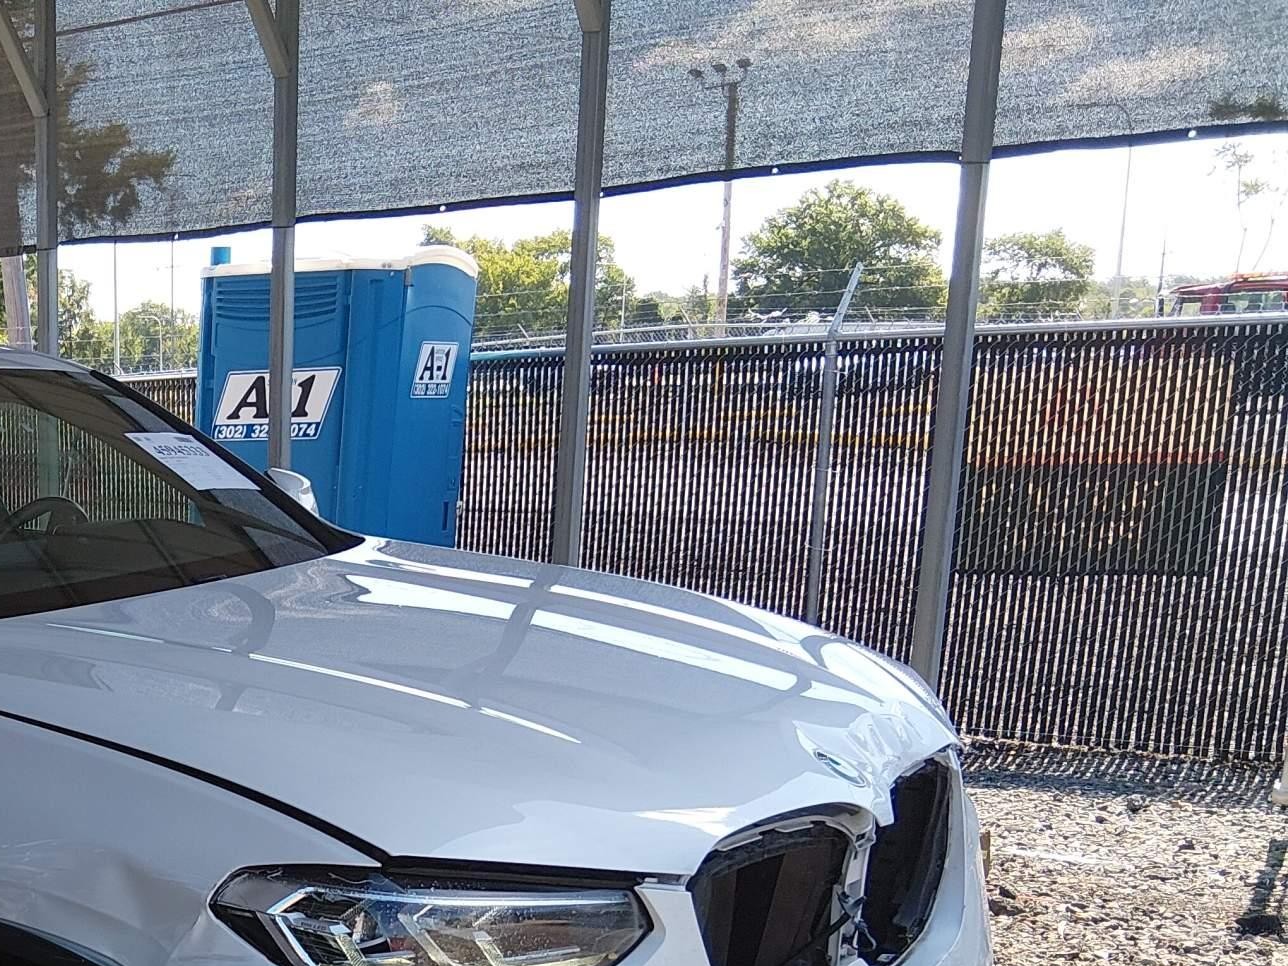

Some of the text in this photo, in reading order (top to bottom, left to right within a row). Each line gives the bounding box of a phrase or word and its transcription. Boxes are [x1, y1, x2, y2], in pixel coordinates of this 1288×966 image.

[418, 345, 452, 381] A-1
[226, 374, 316, 420] A1
[214, 425, 247, 439] (302)
